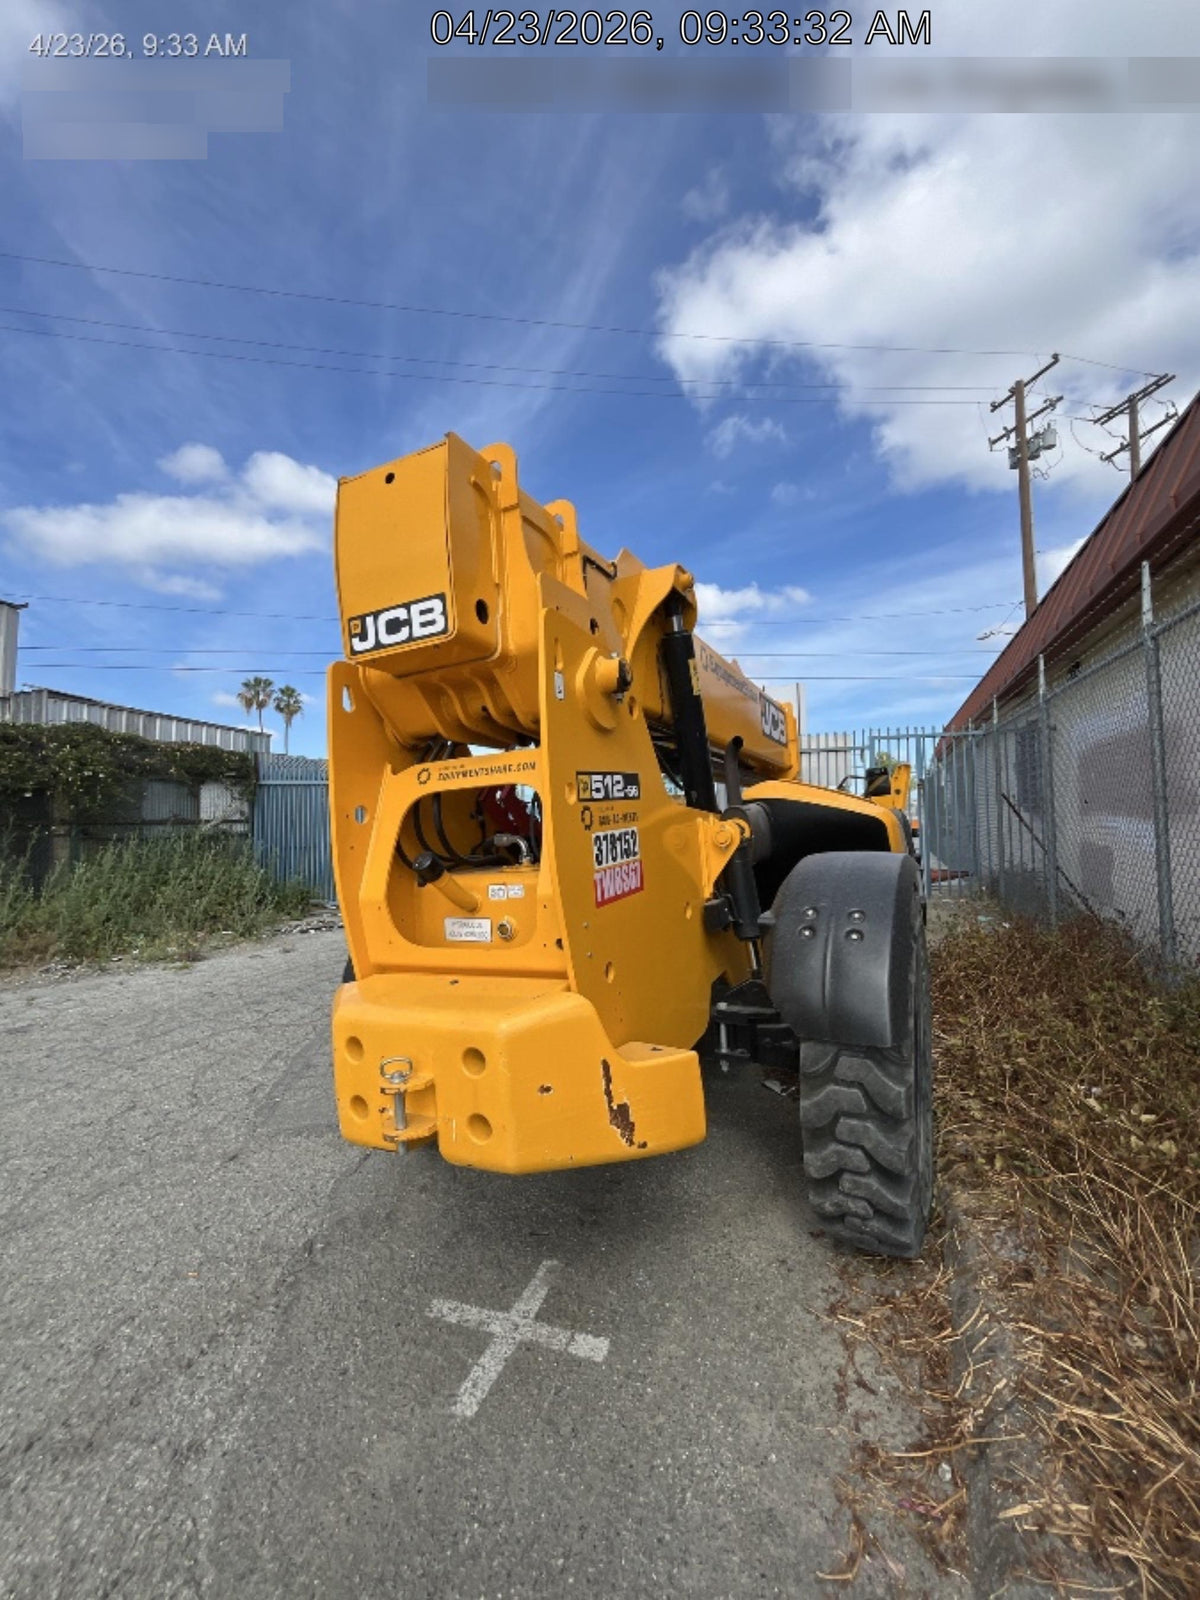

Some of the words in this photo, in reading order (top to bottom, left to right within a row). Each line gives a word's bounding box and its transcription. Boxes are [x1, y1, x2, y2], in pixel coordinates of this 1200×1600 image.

[351, 598, 446, 652] JCB
[763, 699, 787, 745] JCB
[594, 829, 639, 866] 378152
